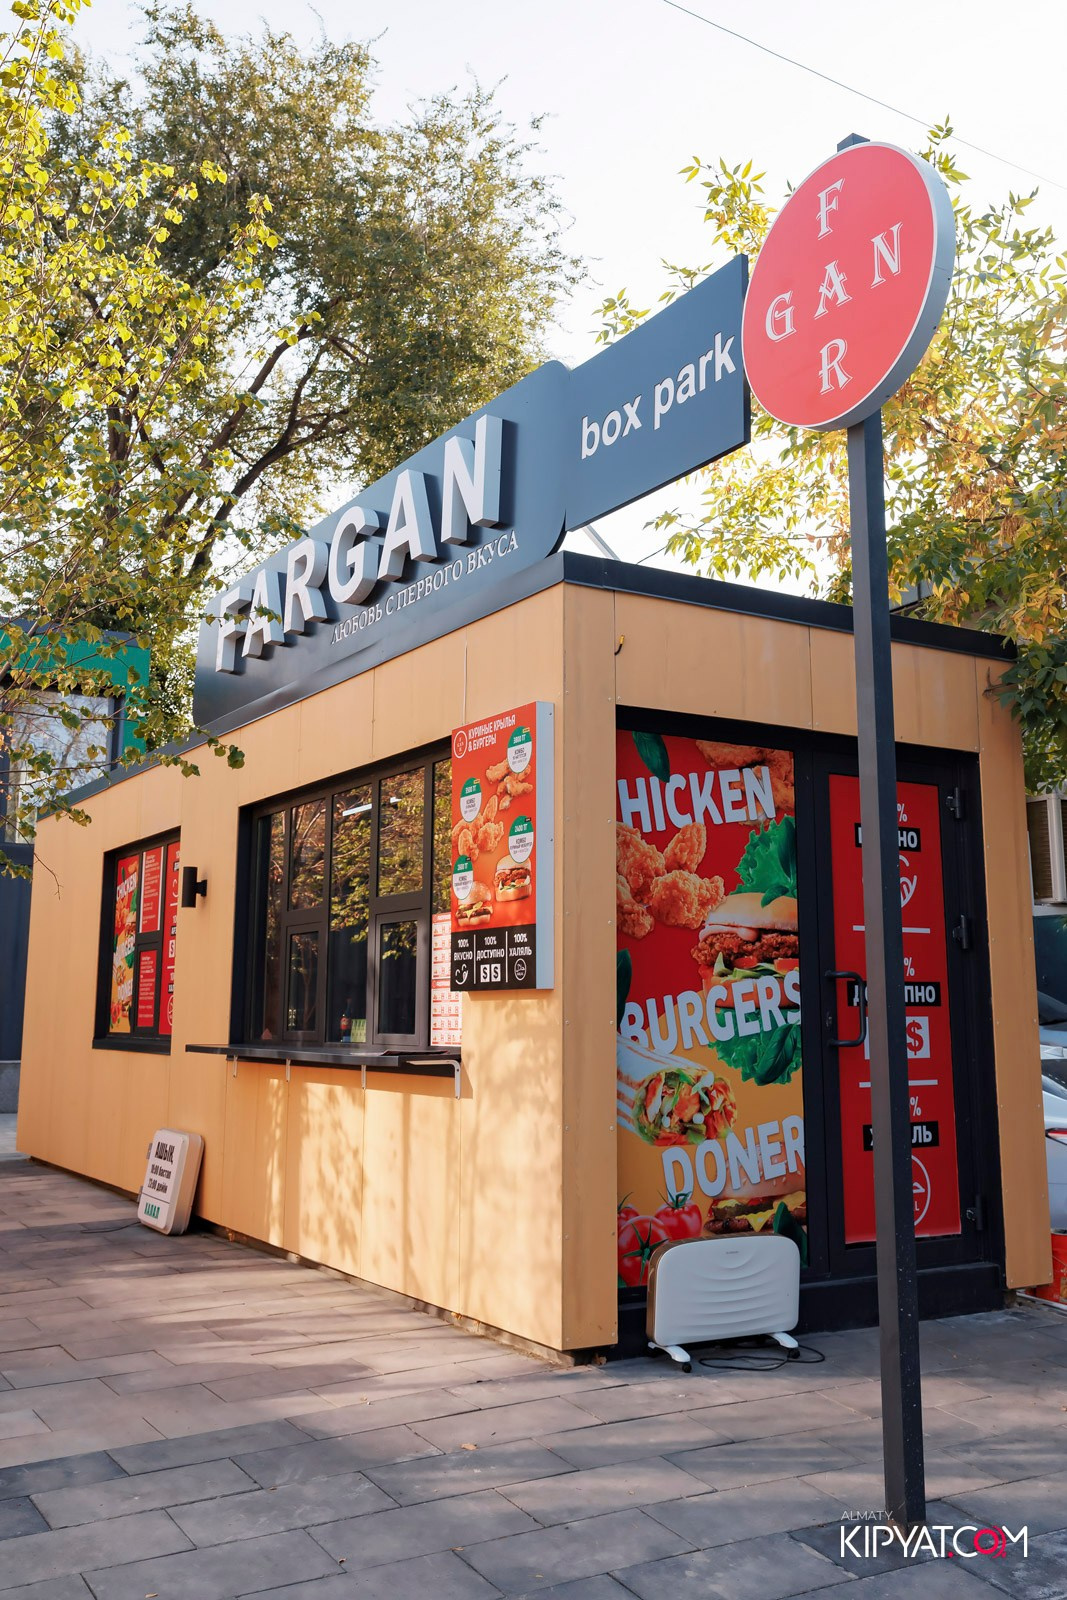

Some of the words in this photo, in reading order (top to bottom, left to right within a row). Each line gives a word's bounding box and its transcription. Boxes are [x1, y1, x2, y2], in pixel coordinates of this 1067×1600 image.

[581, 395, 643, 460] box
[653, 332, 737, 431] park
[215, 414, 503, 674] FARGAN
[331, 606, 383, 645] ЛЮБОВЬ
[397, 560, 463, 611] ПЕРВОГО
[466, 530, 519, 575] ВКУСА
[468, 722, 493, 740] КУРИНЫЕ
[494, 714, 516, 731] КРЫЛЬЯ
[473, 734, 497, 750] БУРГЕРЫ
[458, 939, 469, 948] 100%
[484, 936, 497, 945] 100%
[514, 933, 527, 943] 100%
[453, 951, 473, 961] ВКУСНО
[477, 948, 505, 961] ДОСТУПНО
[509, 946, 533, 957] ХАЛЯЛЬ
[619, 970, 801, 1054] BURGERS
[662, 1115, 806, 1202] DONER
